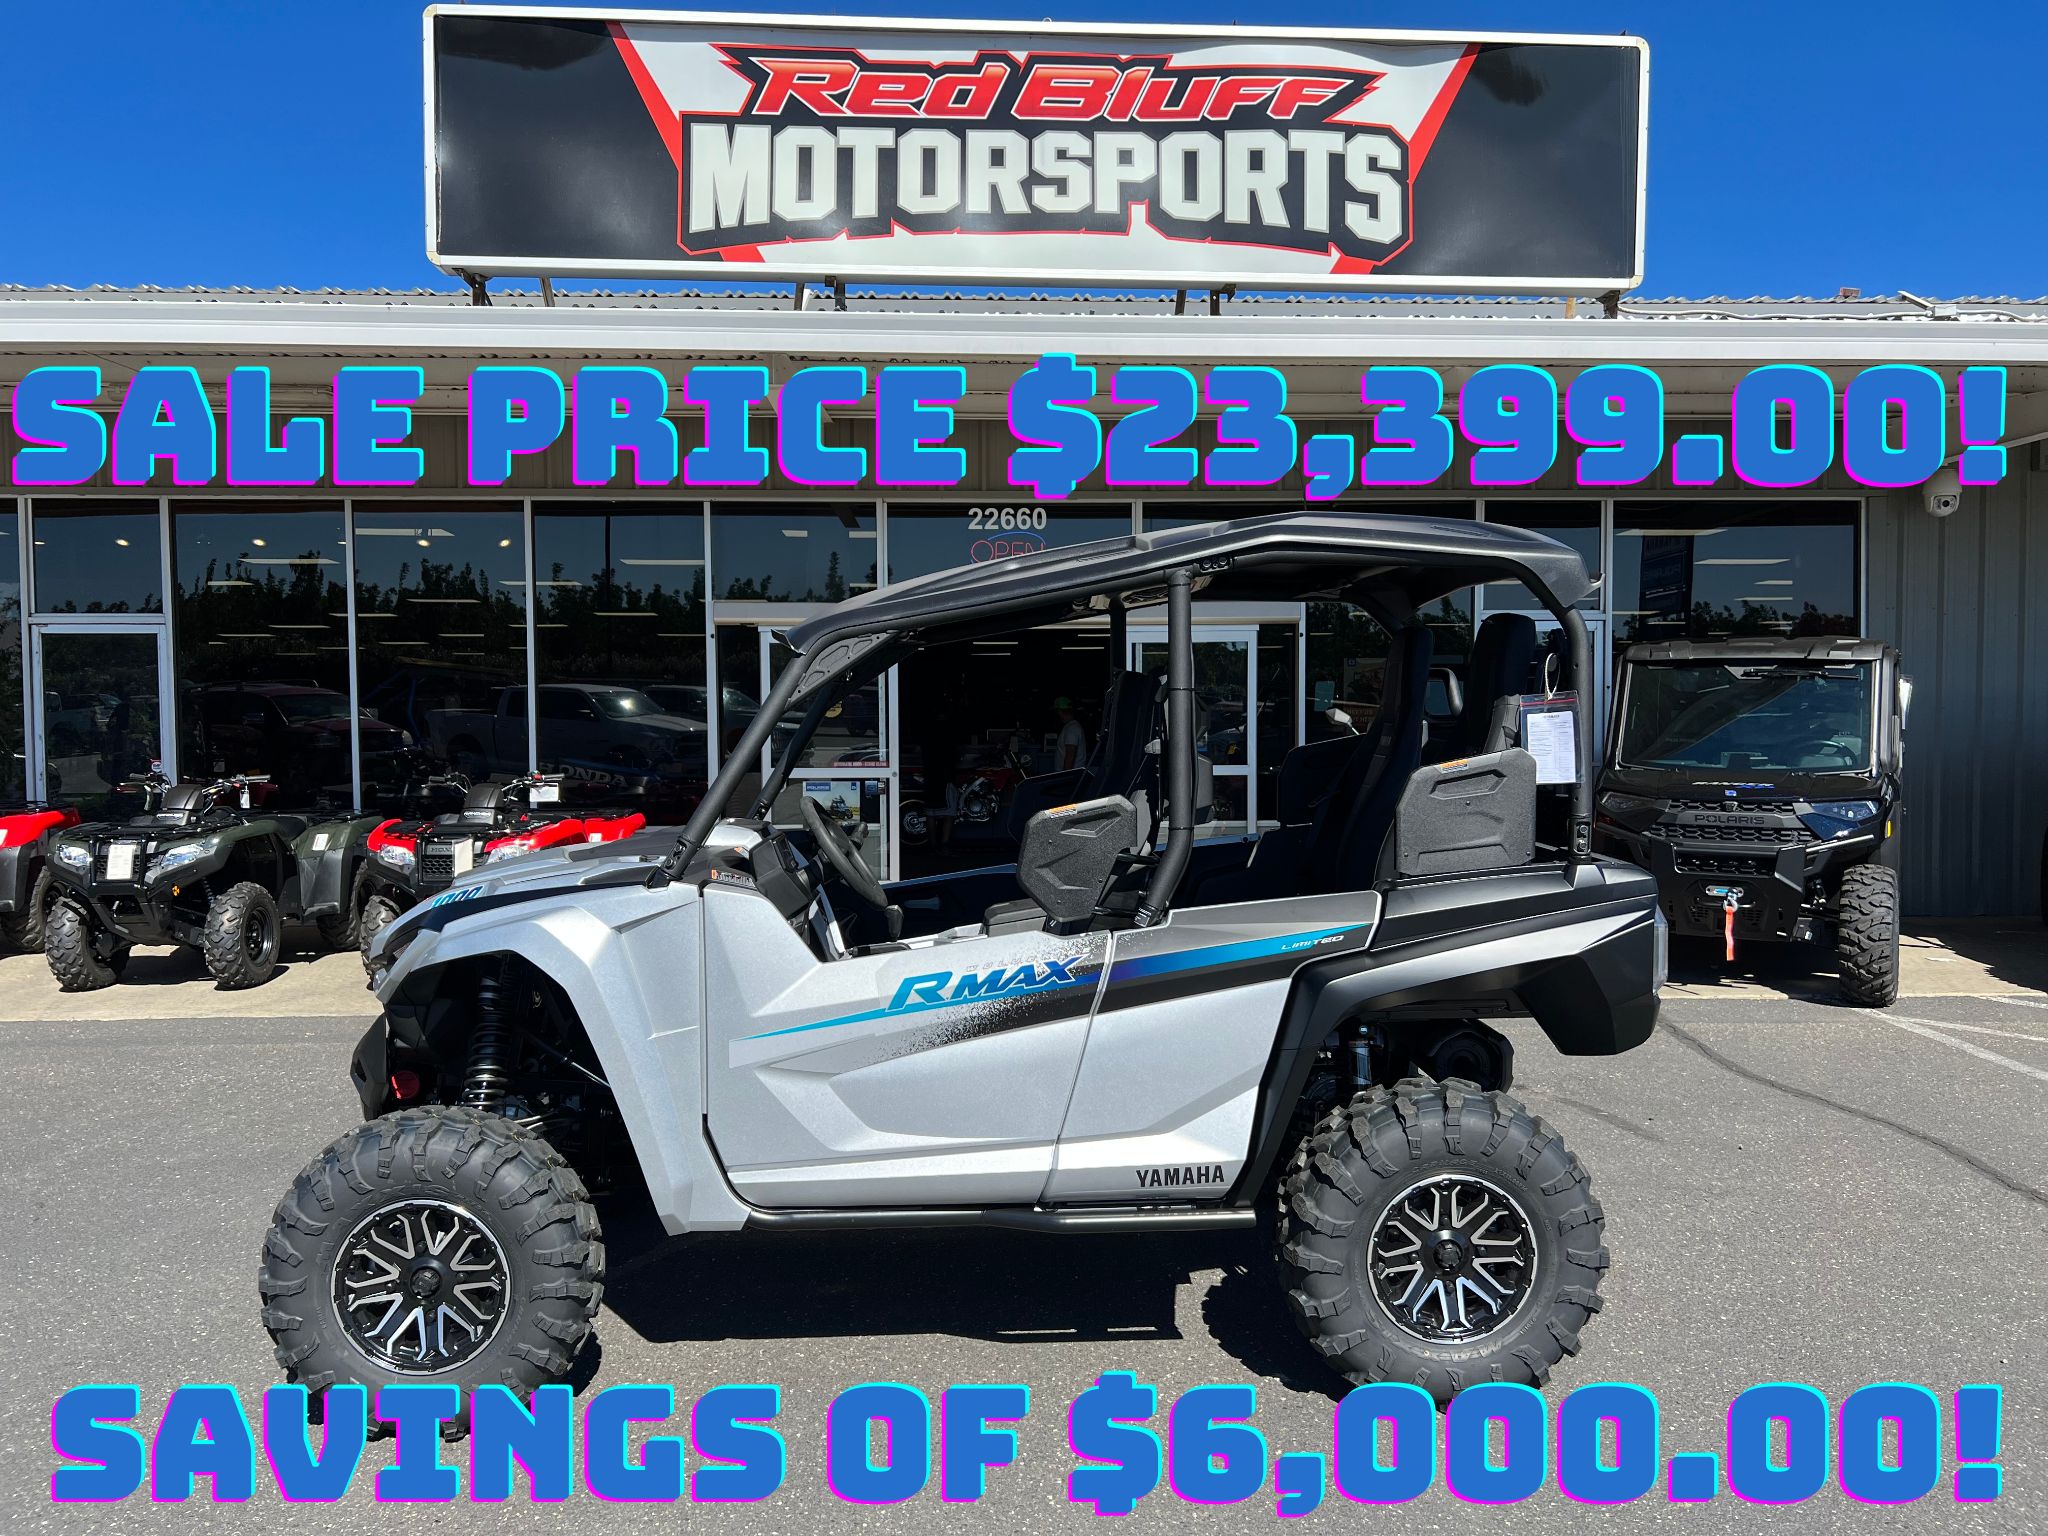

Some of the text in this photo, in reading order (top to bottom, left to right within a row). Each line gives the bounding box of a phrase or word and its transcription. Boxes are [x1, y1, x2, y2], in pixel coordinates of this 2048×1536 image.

[752, 55, 1010, 120] Red
[688, 123, 1403, 244] MOTORSPORTS
[967, 507, 1047, 530] 22660
[1694, 814, 1765, 825] POLARIS
[1281, 935, 1345, 950] LIMITED
[1136, 1165, 1225, 1188] YAMAHA
